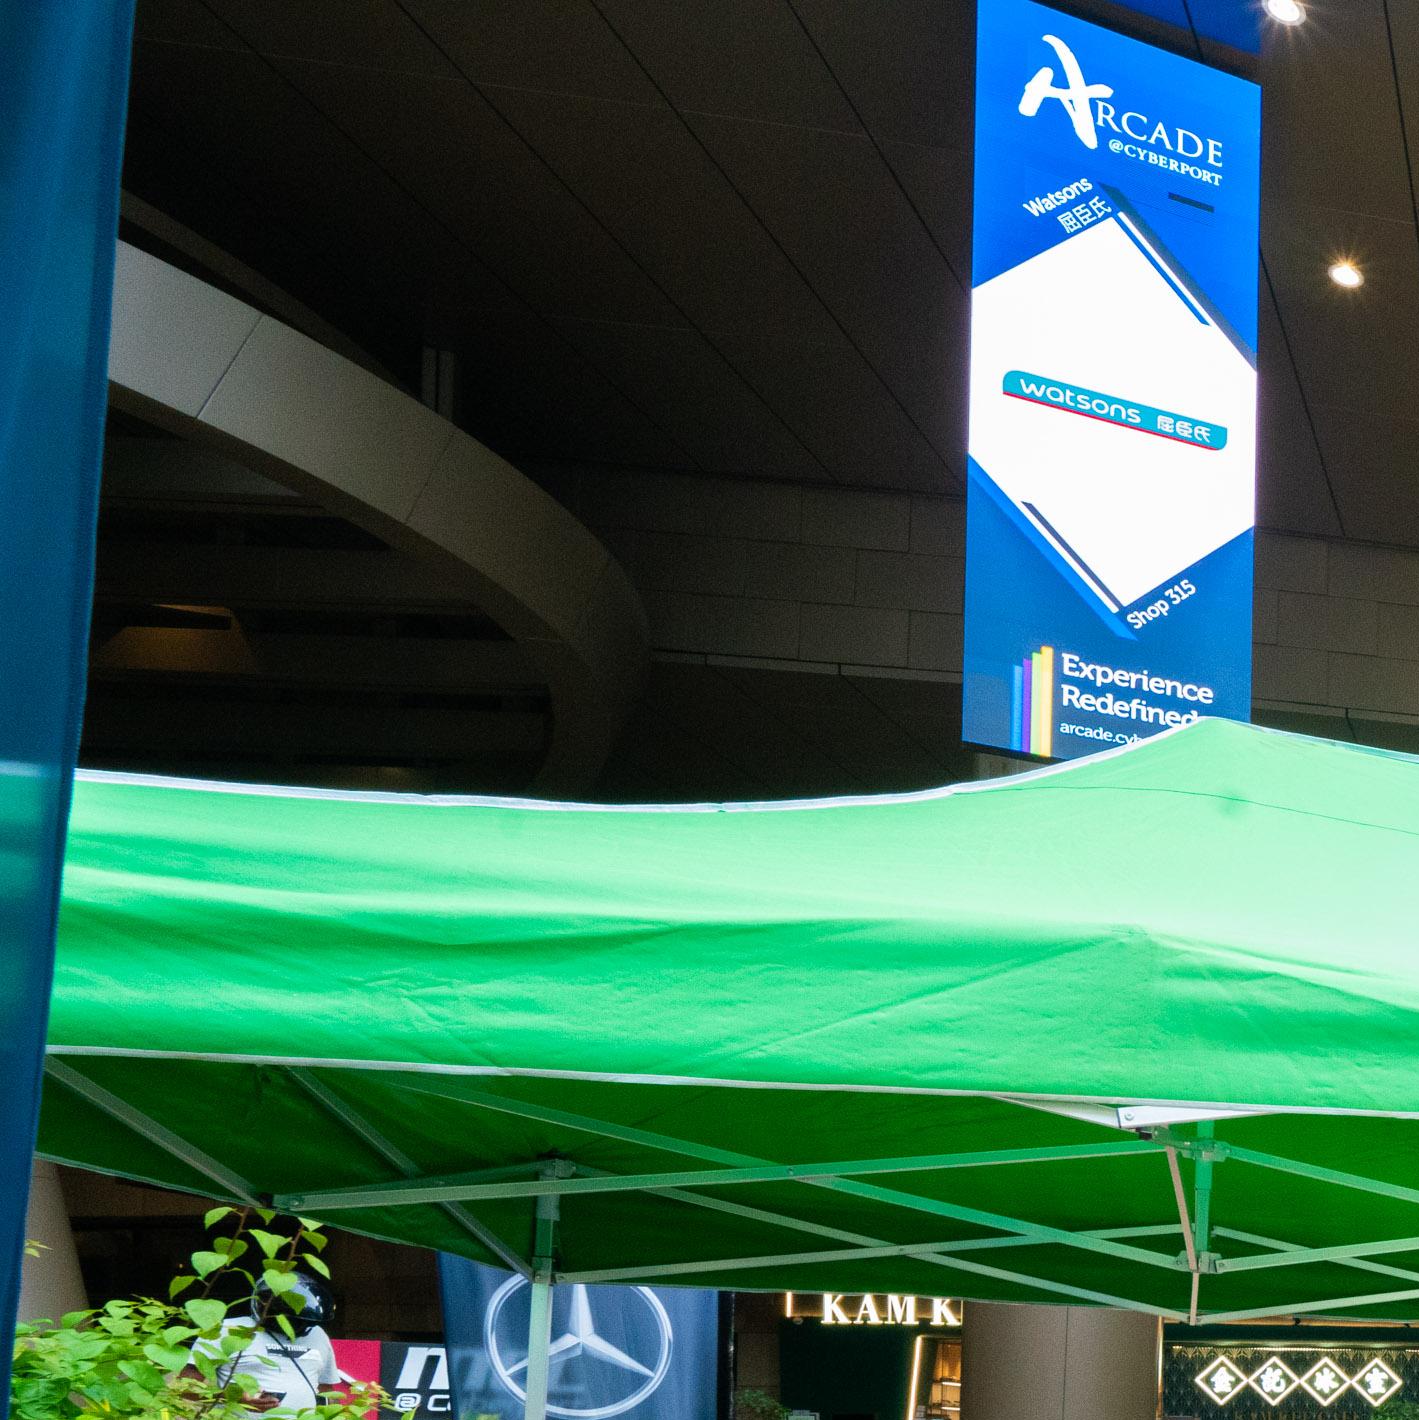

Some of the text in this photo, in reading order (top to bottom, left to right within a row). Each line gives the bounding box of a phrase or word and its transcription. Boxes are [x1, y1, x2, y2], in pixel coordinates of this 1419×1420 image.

[1018, 34, 1223, 167] ARCADE
[1108, 138, 1223, 187] @CYBERPORT
[1022, 177, 1093, 217] Watsons
[1057, 195, 1112, 234] 屈臣氏
[1019, 378, 1142, 425] watsons
[1126, 579, 1196, 629] Shop 315
[1061, 652, 1214, 705] Experience
[1060, 684, 1200, 728] Redefined
[1059, 721, 1148, 745] arcade.cyb
[820, 1293, 920, 1325] KAM
